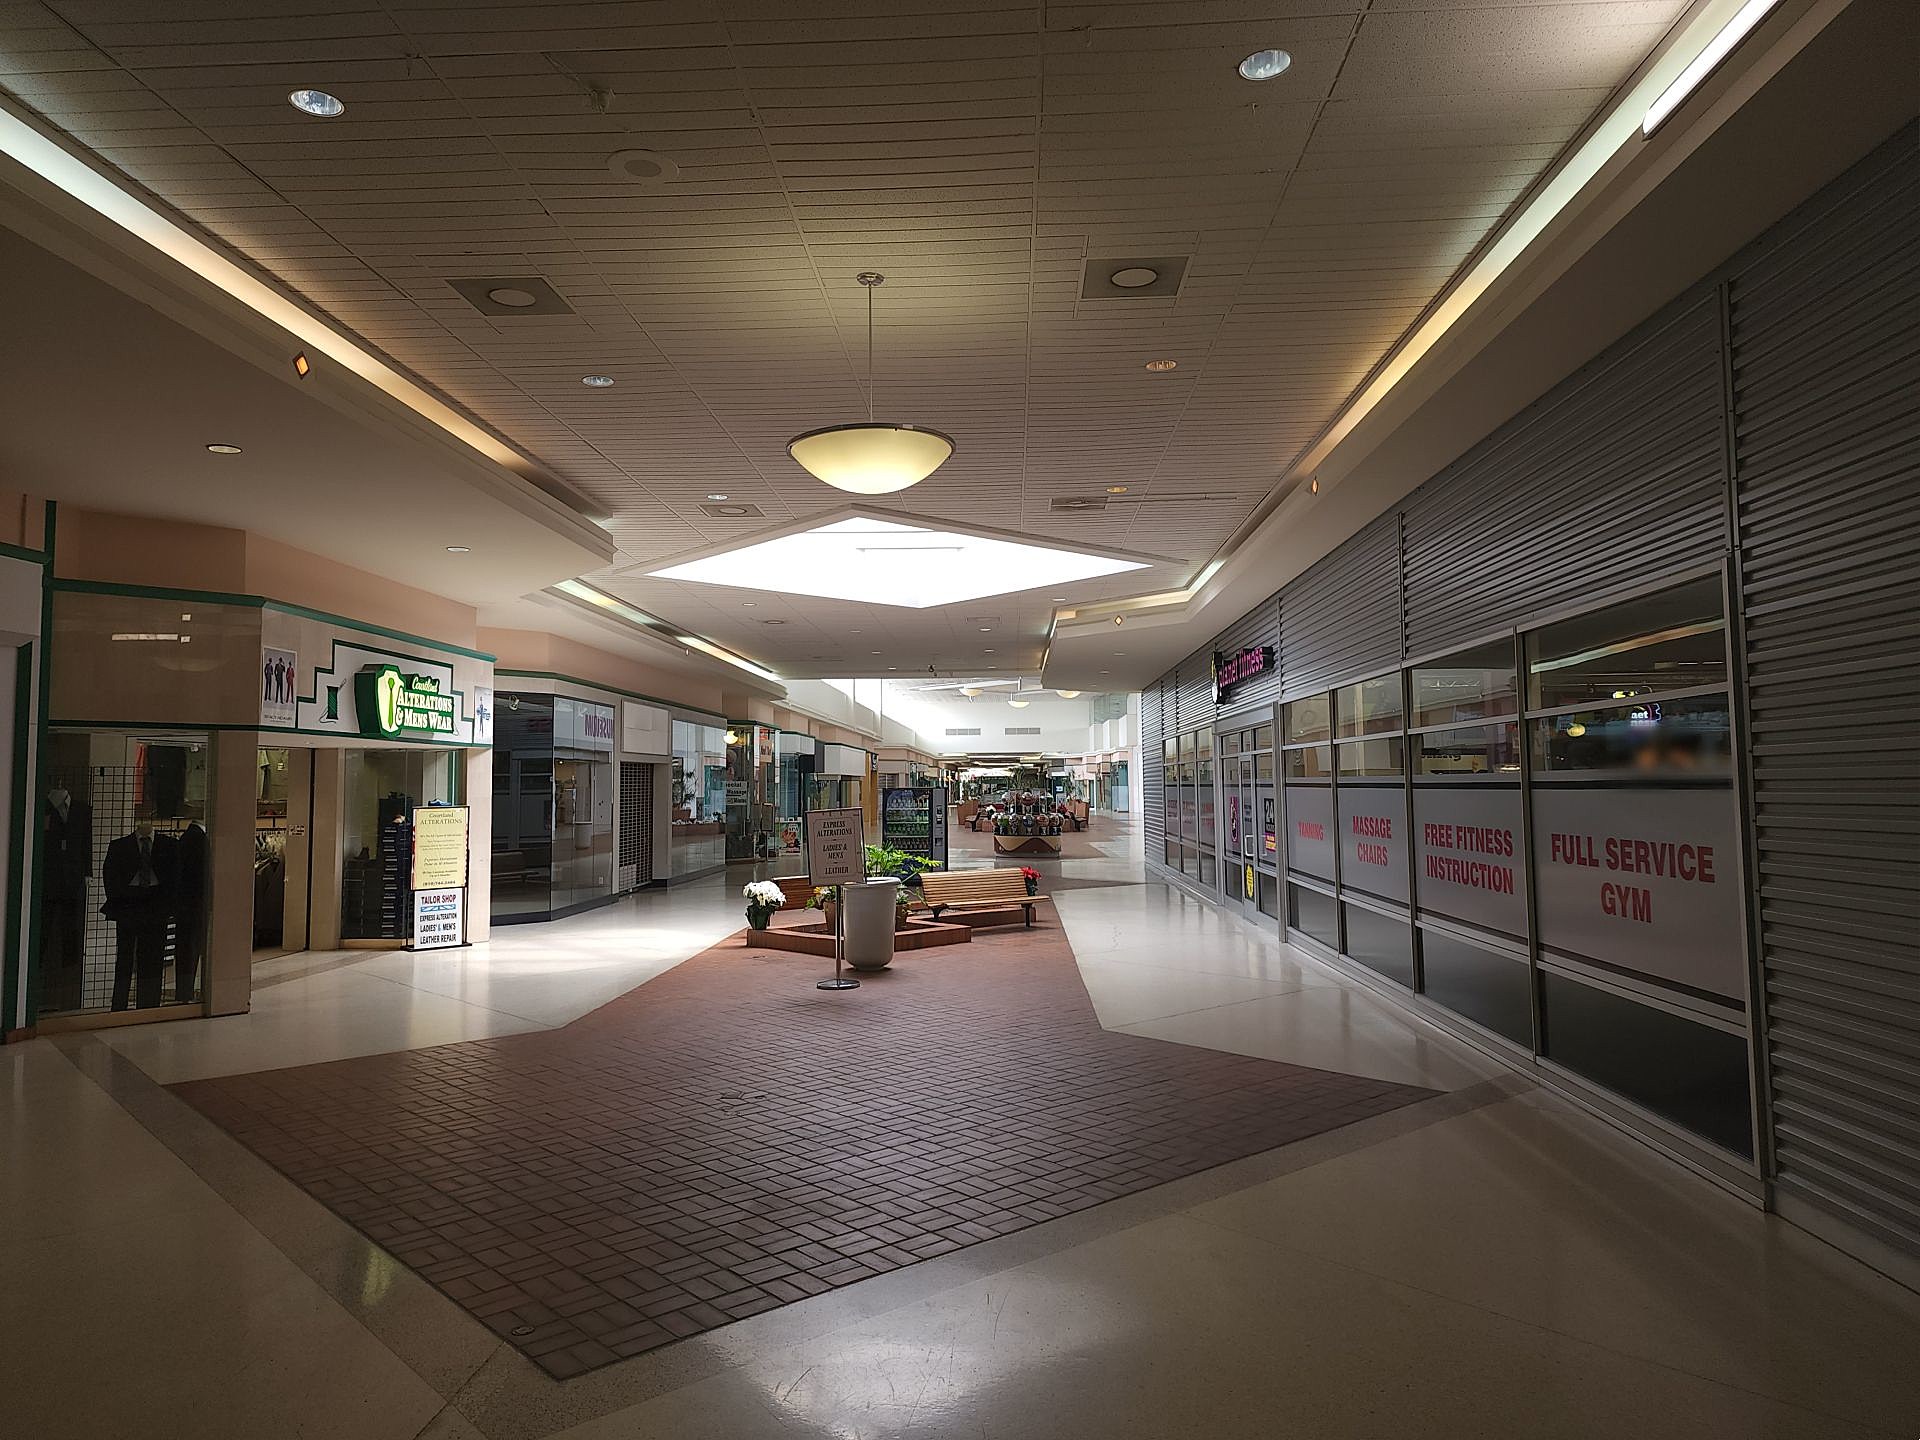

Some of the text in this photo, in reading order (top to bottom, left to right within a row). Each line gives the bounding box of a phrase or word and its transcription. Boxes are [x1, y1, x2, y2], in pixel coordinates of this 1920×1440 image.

[1219, 647, 1264, 688] planet fitness
[397, 686, 452, 713] ALTERATIONS
[395, 709, 404, 726] &
[428, 711, 453, 731] WEAR
[1265, 801, 1275, 824] 24
[817, 828, 853, 837] ALTERATIONS
[823, 821, 846, 829] EXPRESS
[1352, 815, 1392, 839] MASSAGE
[1424, 823, 1513, 857] FREE FITNESS
[1357, 842, 1388, 866] CHAIRS
[1551, 833, 1716, 883] FULL SERVICE
[825, 867, 849, 875] LEATHER
[1426, 855, 1514, 895] INSTRUCTION
[421, 894, 457, 904] TAILOR SHOP
[1601, 882, 1652, 923] GYM
[420, 912, 457, 922] EXPRESS ALTERATION
[420, 934, 456, 944] LEATHER REPAIR
